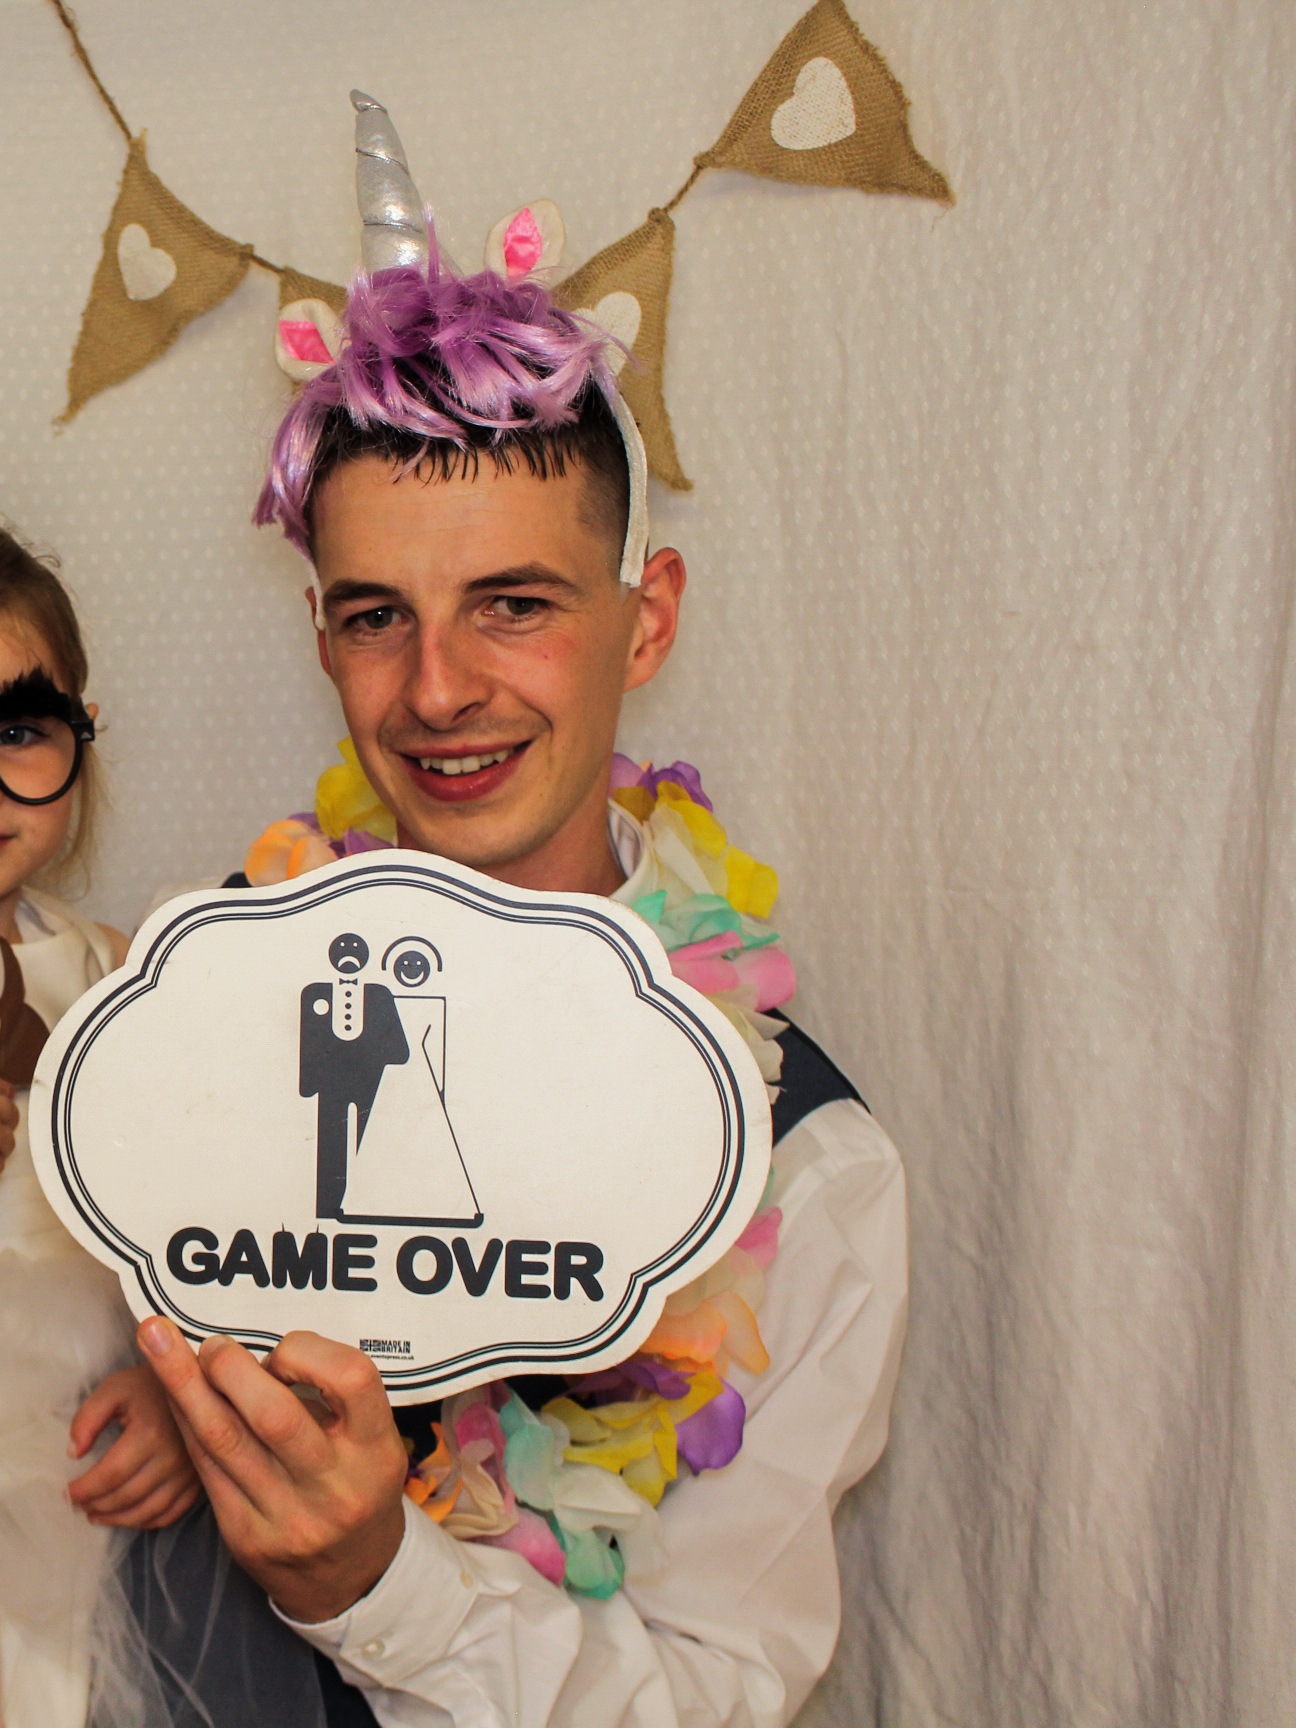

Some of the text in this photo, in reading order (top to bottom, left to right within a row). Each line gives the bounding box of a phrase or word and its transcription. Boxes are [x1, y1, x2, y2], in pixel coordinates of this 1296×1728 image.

[166, 1226, 604, 1302] GAME OVER
[403, 1340, 411, 1348] IN
[381, 1346, 411, 1354] BRITAIN
